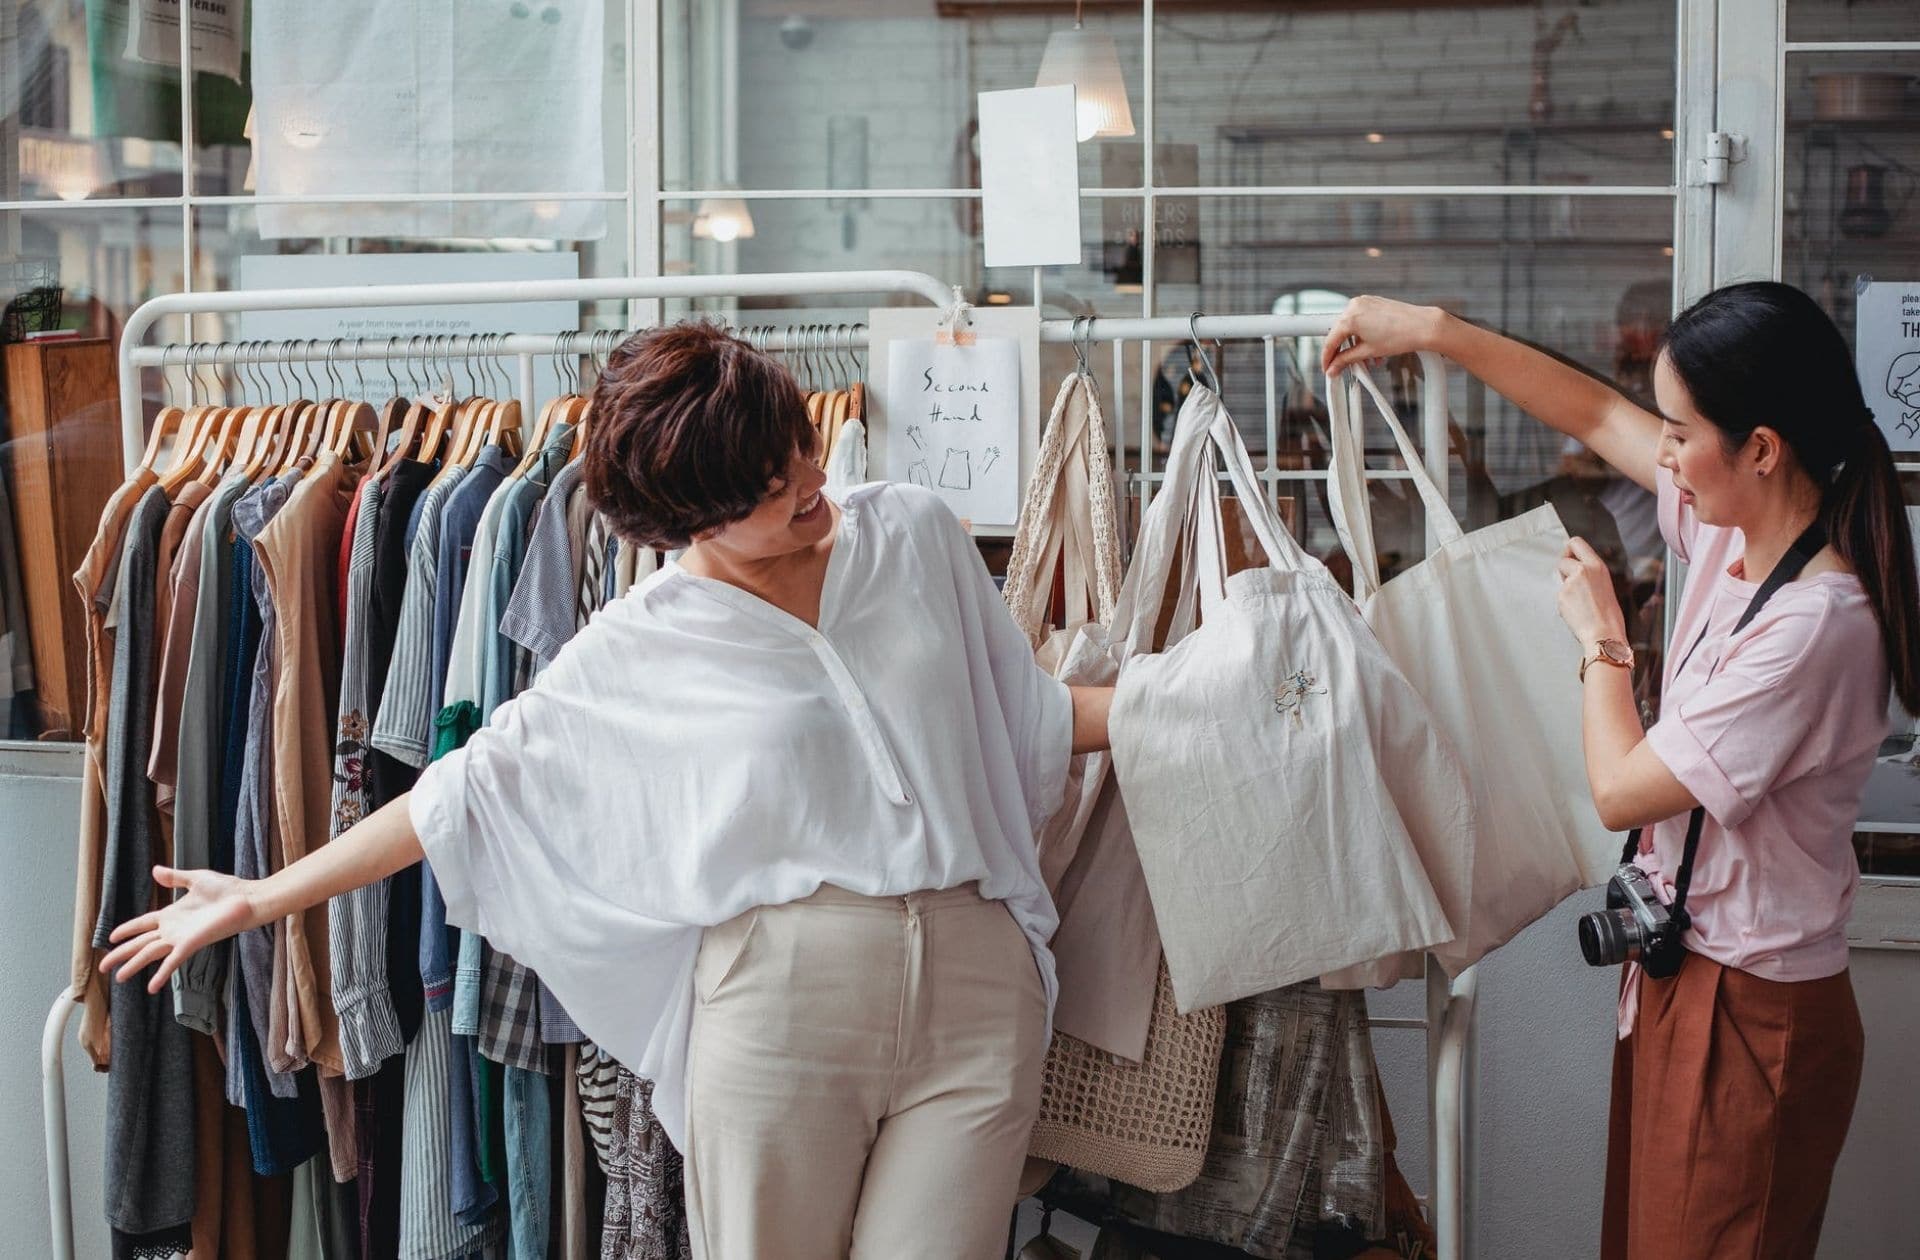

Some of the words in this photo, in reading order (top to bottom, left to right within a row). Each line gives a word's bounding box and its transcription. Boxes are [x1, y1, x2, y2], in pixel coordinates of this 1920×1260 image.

[1903, 306, 1920, 316] take
[1901, 322, 1920, 338] TH
[924, 367, 989, 392] Second
[929, 402, 982, 424] Hand
